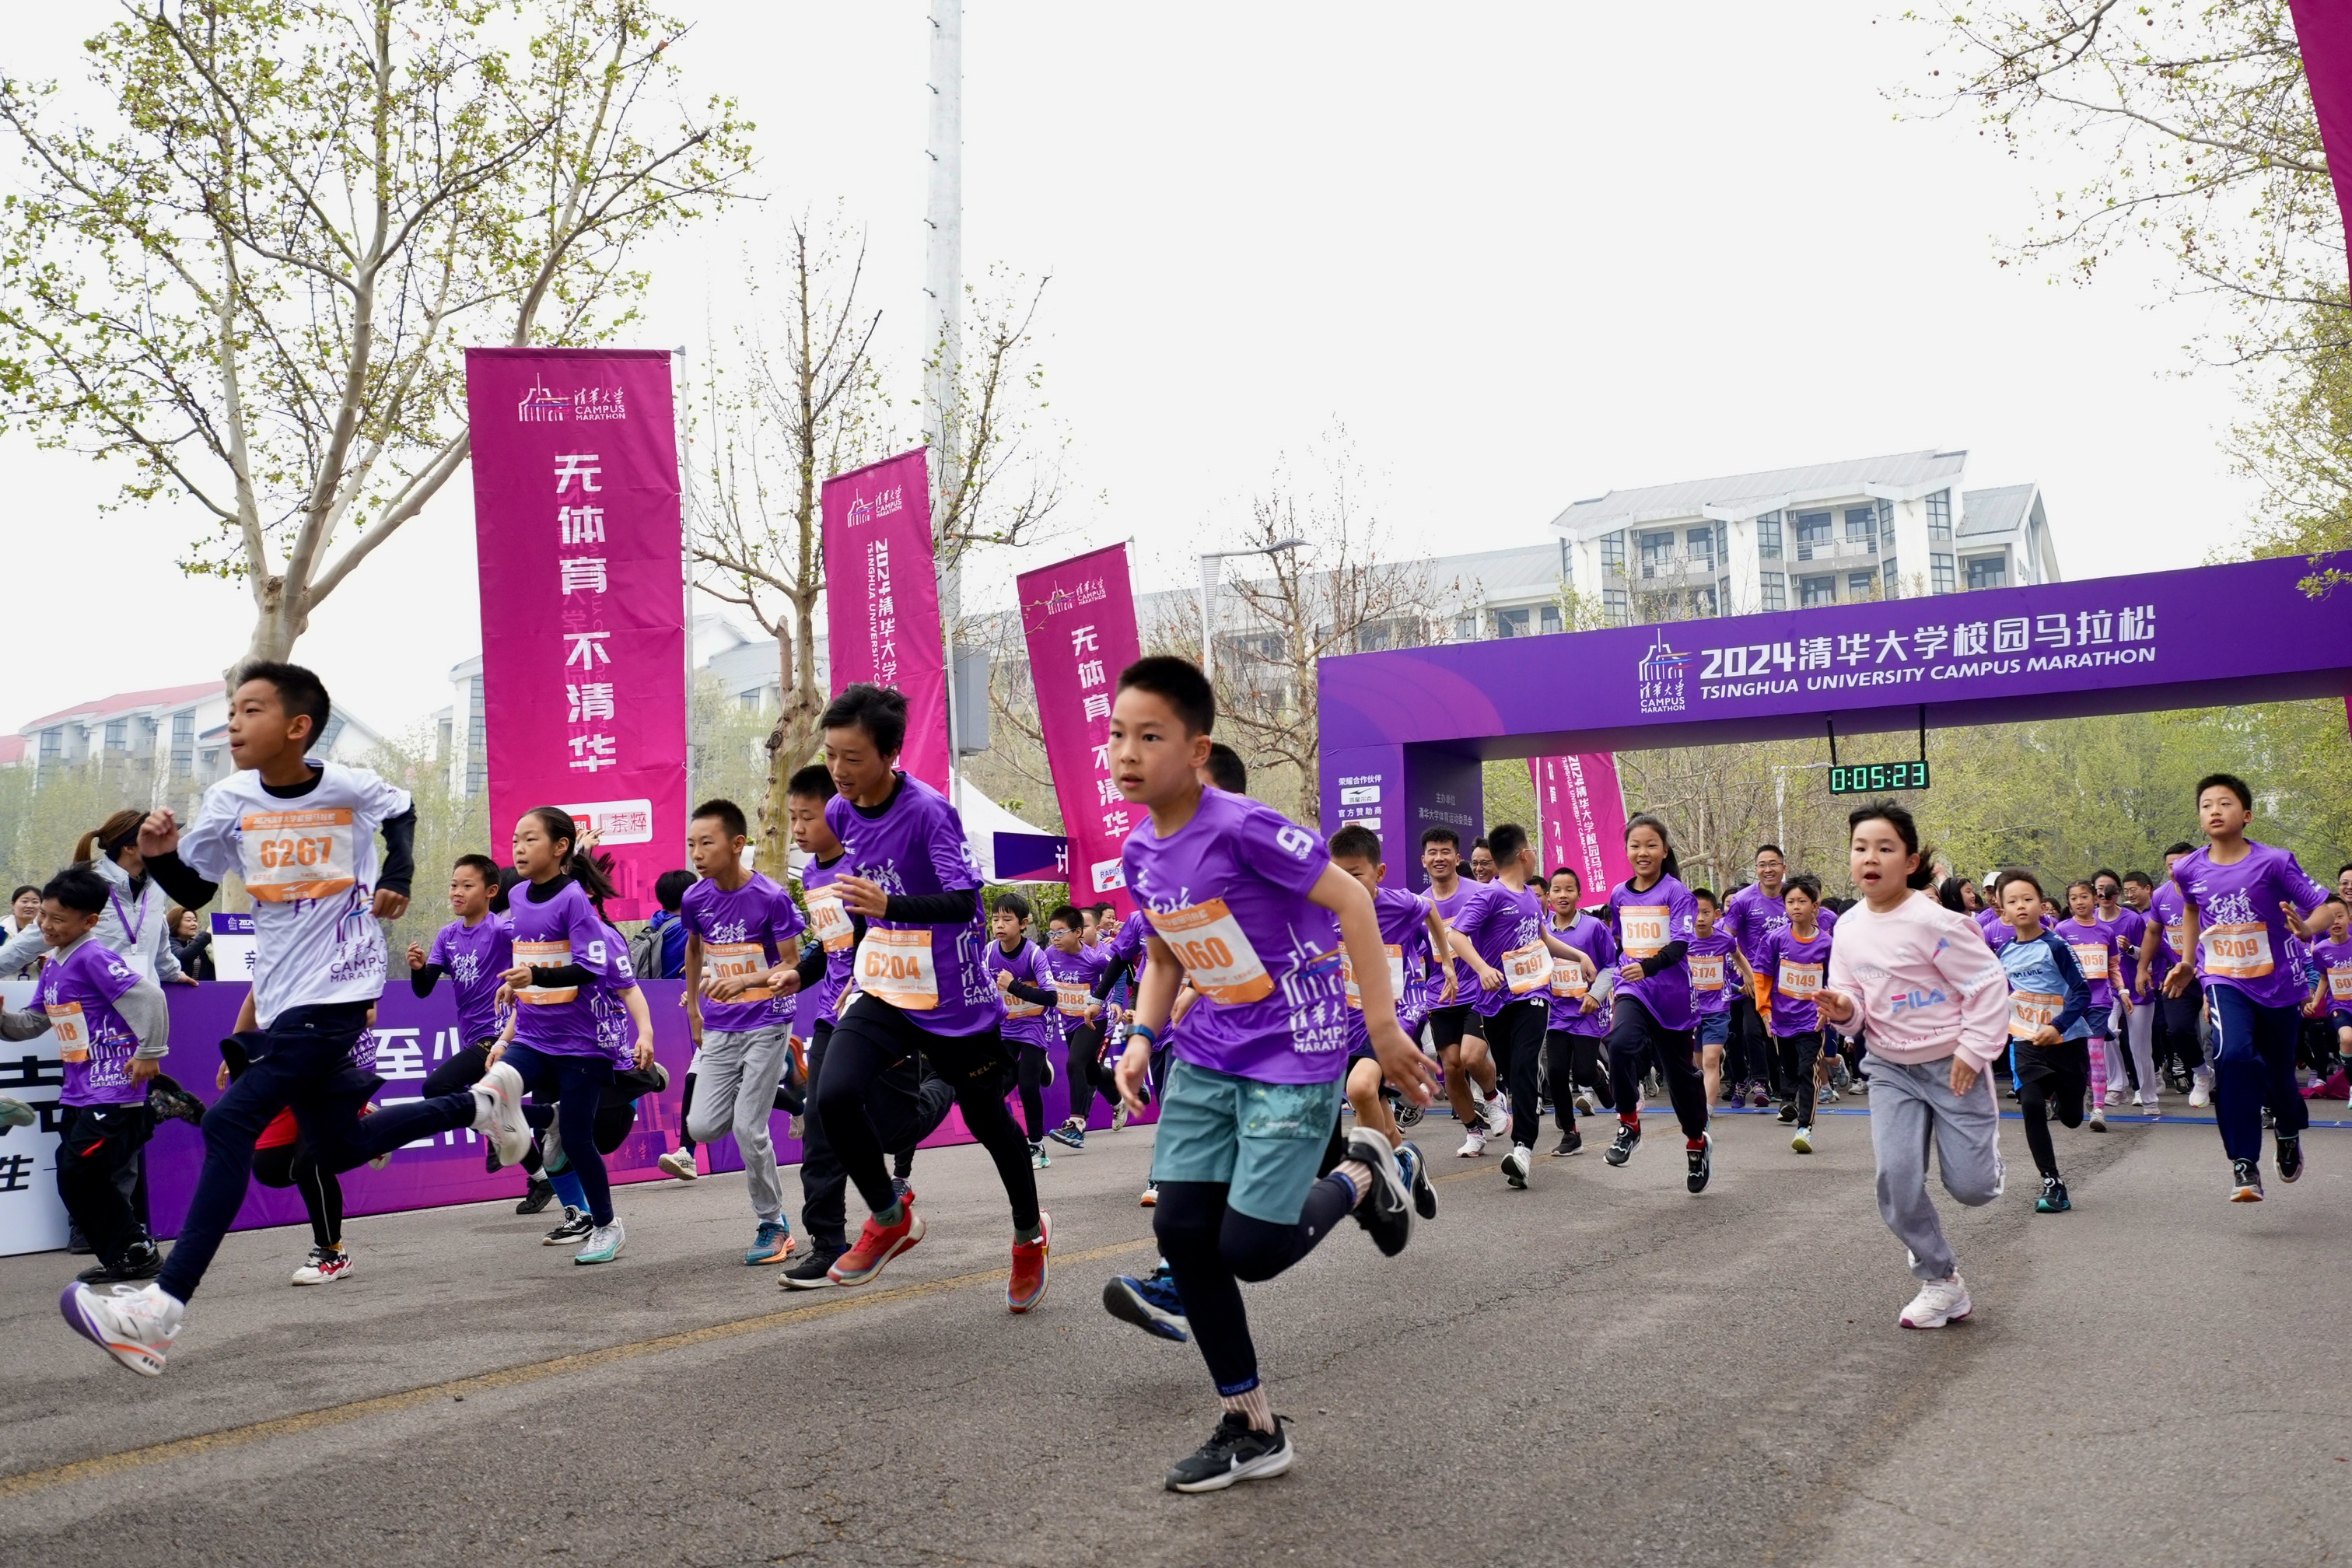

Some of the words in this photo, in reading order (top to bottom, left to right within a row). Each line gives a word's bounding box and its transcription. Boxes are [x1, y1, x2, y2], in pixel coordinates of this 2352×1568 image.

[576, 405, 625, 415] CAMPUS
[876, 499, 902, 515] CAMPUS
[876, 506, 902, 519] MARATHON
[866, 541, 876, 600] TSINGHUA
[1077, 588, 1106, 601] CAMPUS
[875, 538, 898, 691] 2024清华大学
[869, 603, 880, 670] UNIVERSITY
[1699, 605, 2157, 679] 2024清华大学校园马拉松
[1700, 678, 1799, 700] TSINGHUA
[1807, 667, 1925, 691] UNIVERSITY
[1930, 660, 2021, 681] CAMPUS
[2026, 647, 2157, 673] MARATHON
[1640, 697, 1685, 708] CAMPUS
[1641, 705, 1685, 714] MARATHON
[1832, 763, 1925, 791] 0:05:23
[1338, 806, 1382, 817] 官方赞助商
[1562, 757, 1573, 789] TSINGHUA
[1570, 789, 1583, 827] UNIVERSITY
[1578, 828, 1588, 855] CAMPUS
[1584, 856, 1595, 893] MARATHON
[261, 836, 333, 868] 6267
[1626, 922, 1661, 939] 6160
[1171, 937, 1234, 970] 060
[2212, 938, 2259, 958] 6209
[330, 957, 387, 973] CAMPU
[330, 964, 387, 983] MARATHO
[865, 951, 922, 980] 6204
[1692, 966, 1717, 978] 6174
[1787, 972, 1816, 987] 6149
[1891, 988, 1947, 1013] FILA
[1294, 1038, 1346, 1053] MARATH
[969, 1061, 997, 1077] KELM
